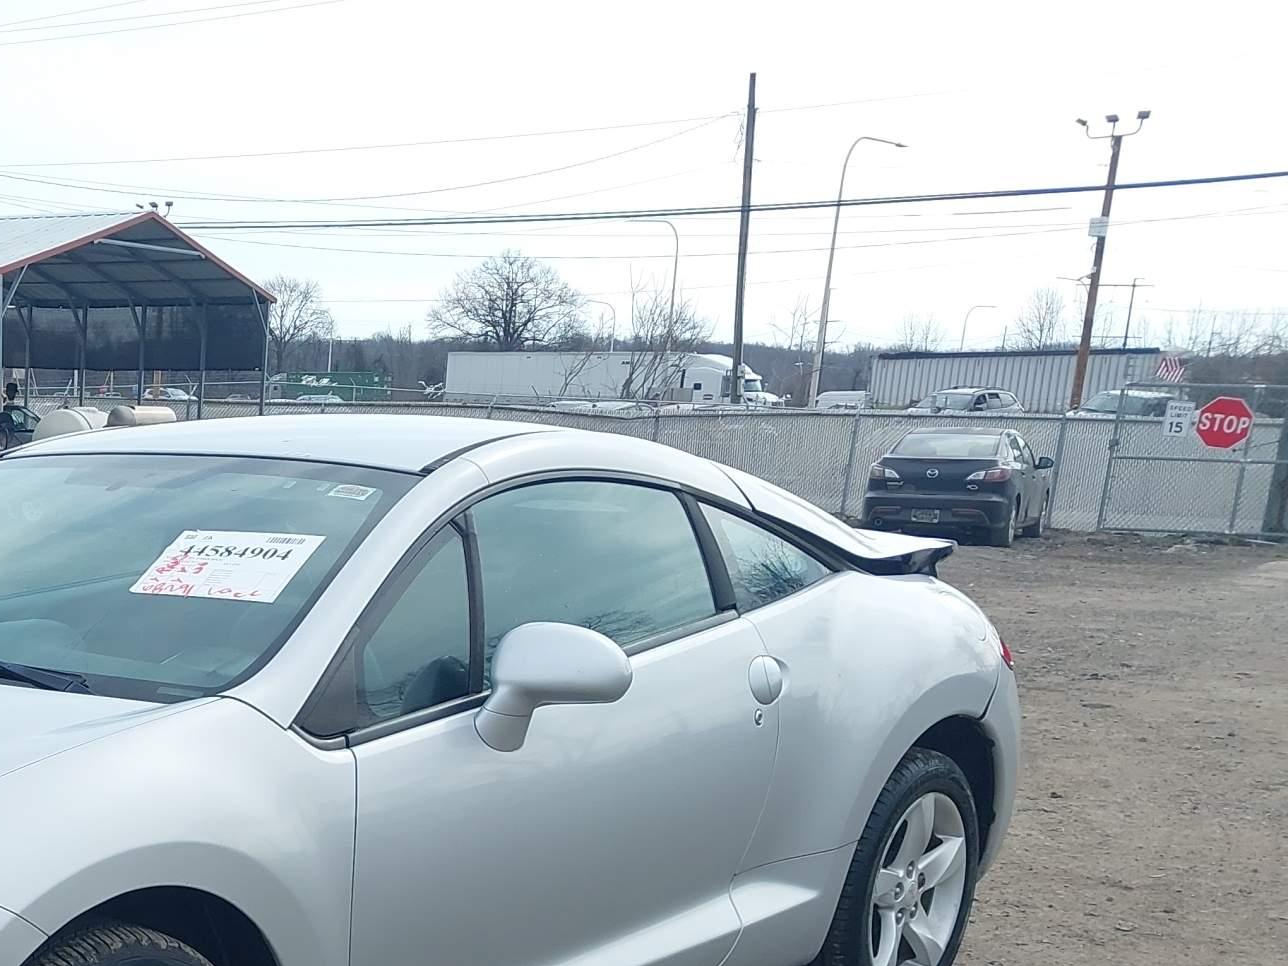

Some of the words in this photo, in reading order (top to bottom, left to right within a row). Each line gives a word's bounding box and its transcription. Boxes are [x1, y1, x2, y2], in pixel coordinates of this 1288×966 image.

[1170, 404, 1192, 412] SPEED
[1168, 421, 1184, 433] 15
[1198, 412, 1250, 434] STOP
[179, 544, 294, 562] 44584904
